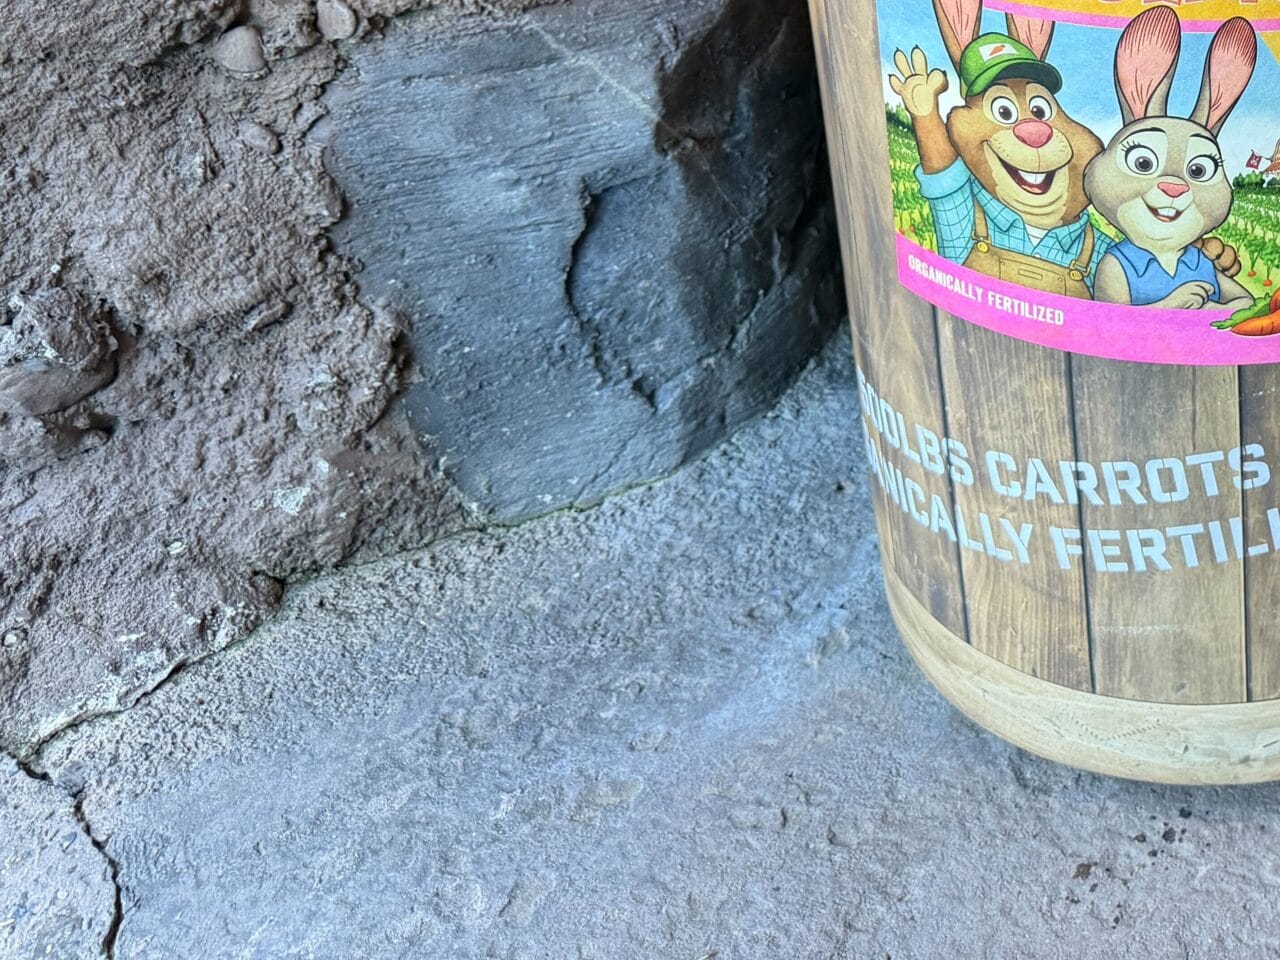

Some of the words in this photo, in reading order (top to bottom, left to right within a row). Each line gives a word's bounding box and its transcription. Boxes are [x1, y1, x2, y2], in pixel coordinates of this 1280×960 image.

[908, 254, 984, 303] ORGANICALLY
[988, 291, 1065, 326] FERTILIZED
[985, 443, 1271, 505] CARROTS
